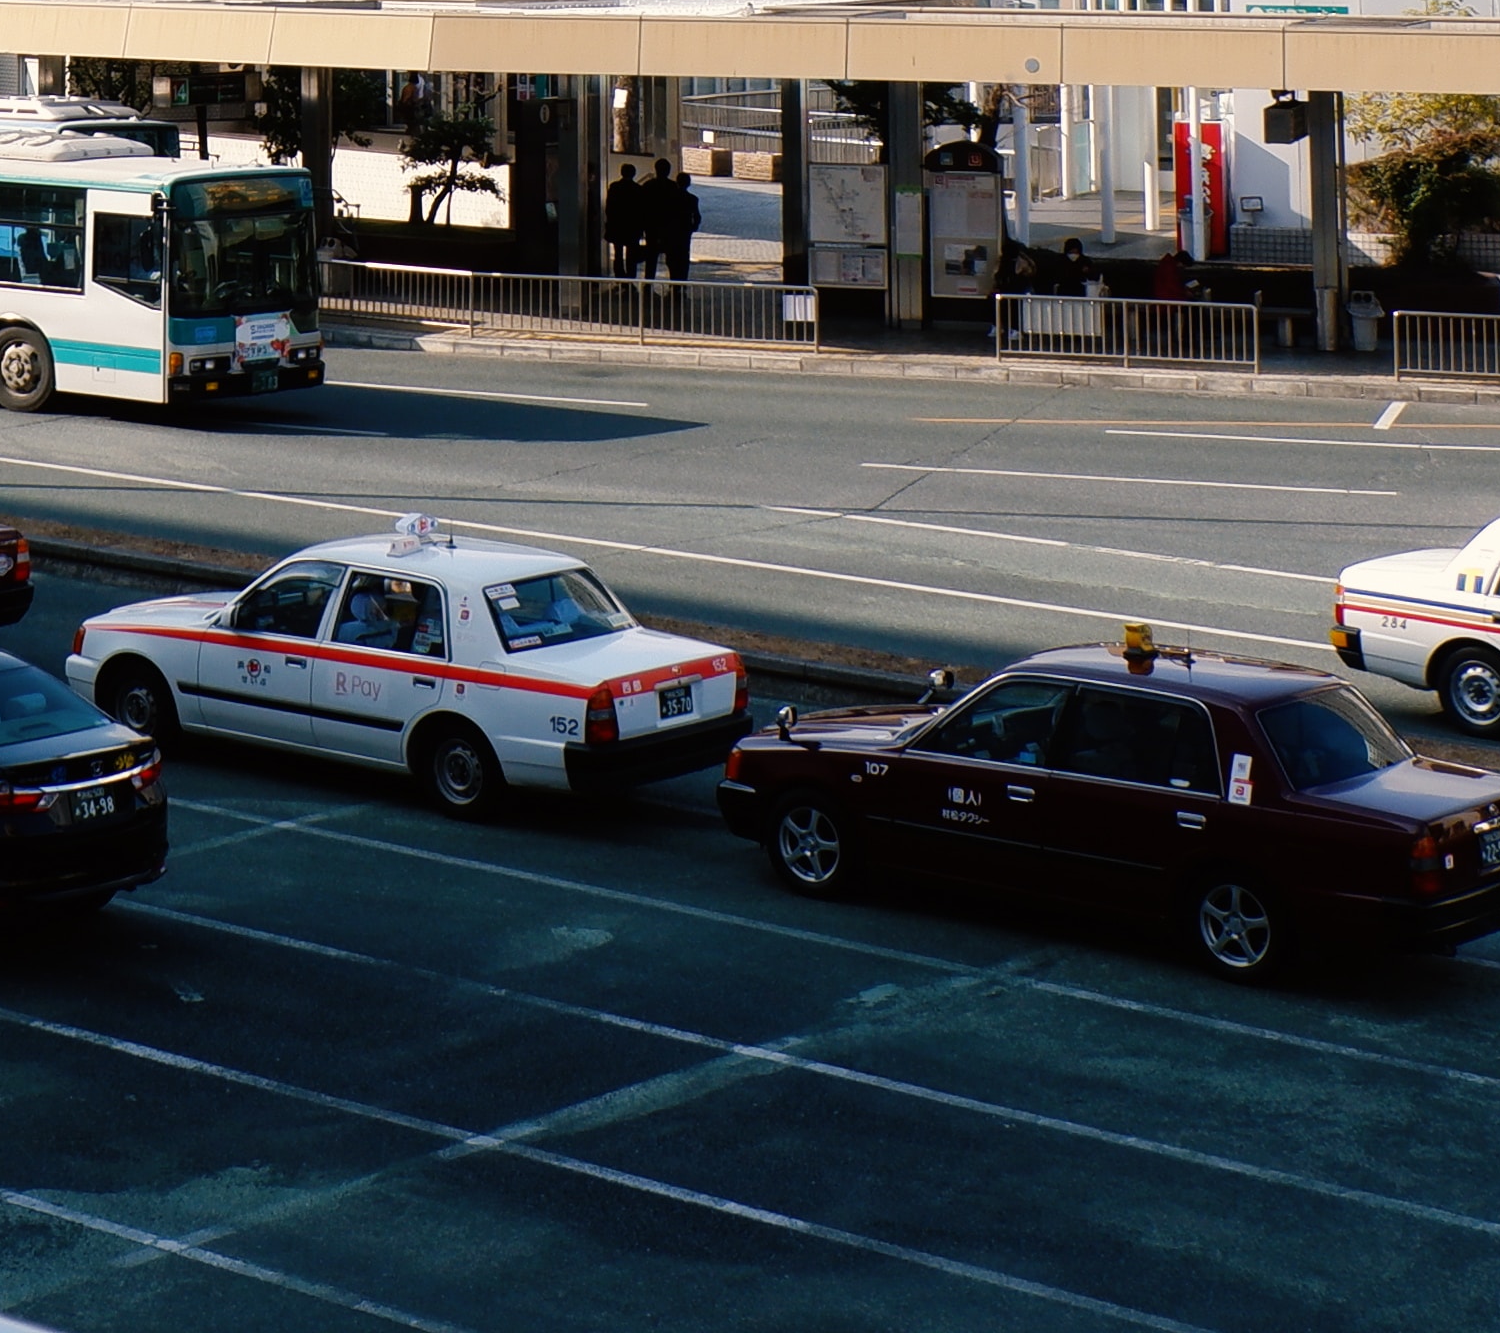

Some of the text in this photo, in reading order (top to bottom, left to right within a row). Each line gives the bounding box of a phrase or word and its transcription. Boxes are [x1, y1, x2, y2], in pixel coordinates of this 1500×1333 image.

[172, 84, 188, 101] 14
[1381, 616, 1407, 630] 284
[712, 658, 728, 671] 152
[336, 672, 382, 702] R Pay
[667, 696, 692, 716] 35-70
[550, 716, 579, 736] 152
[864, 761, 888, 777] 107
[80, 795, 115, 819] 34-98
